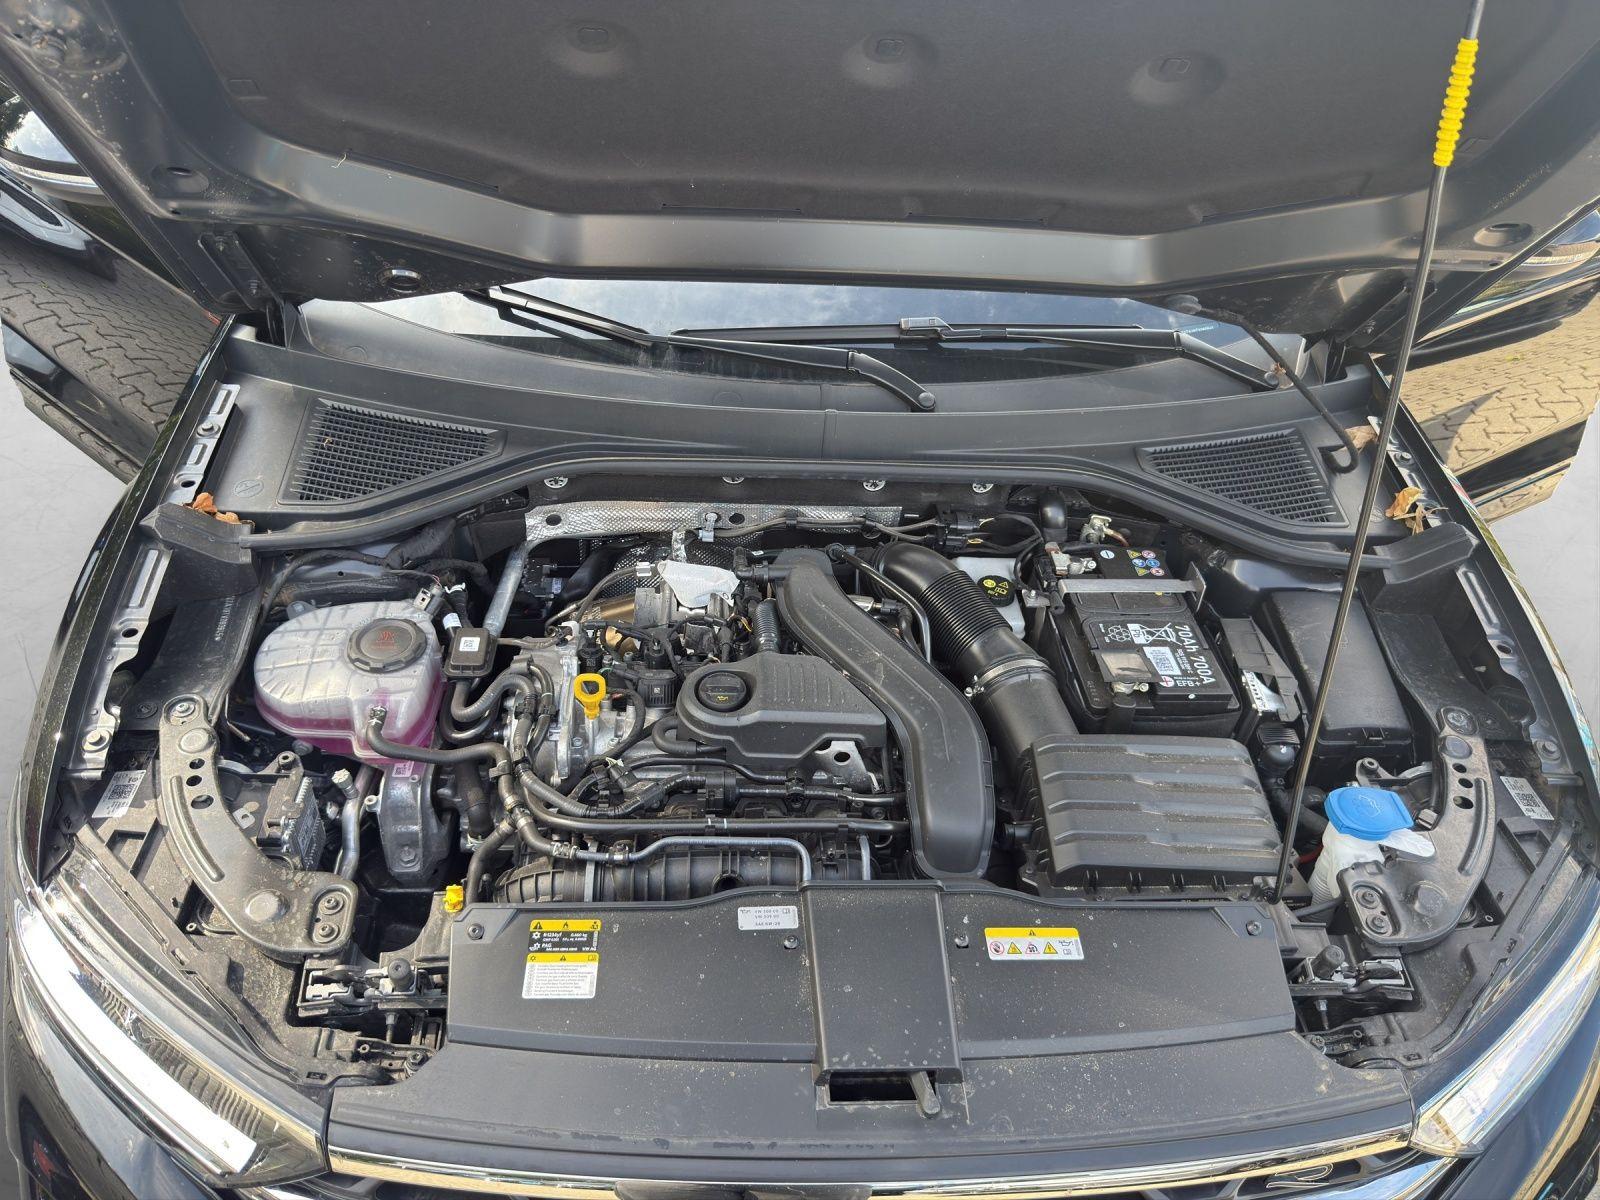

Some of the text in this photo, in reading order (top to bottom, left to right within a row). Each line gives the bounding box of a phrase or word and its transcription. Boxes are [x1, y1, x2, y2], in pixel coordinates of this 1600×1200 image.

[1131, 629, 1142, 638] Pb
[1174, 625, 1199, 652] 70Ah
[1190, 655, 1216, 684] 700A
